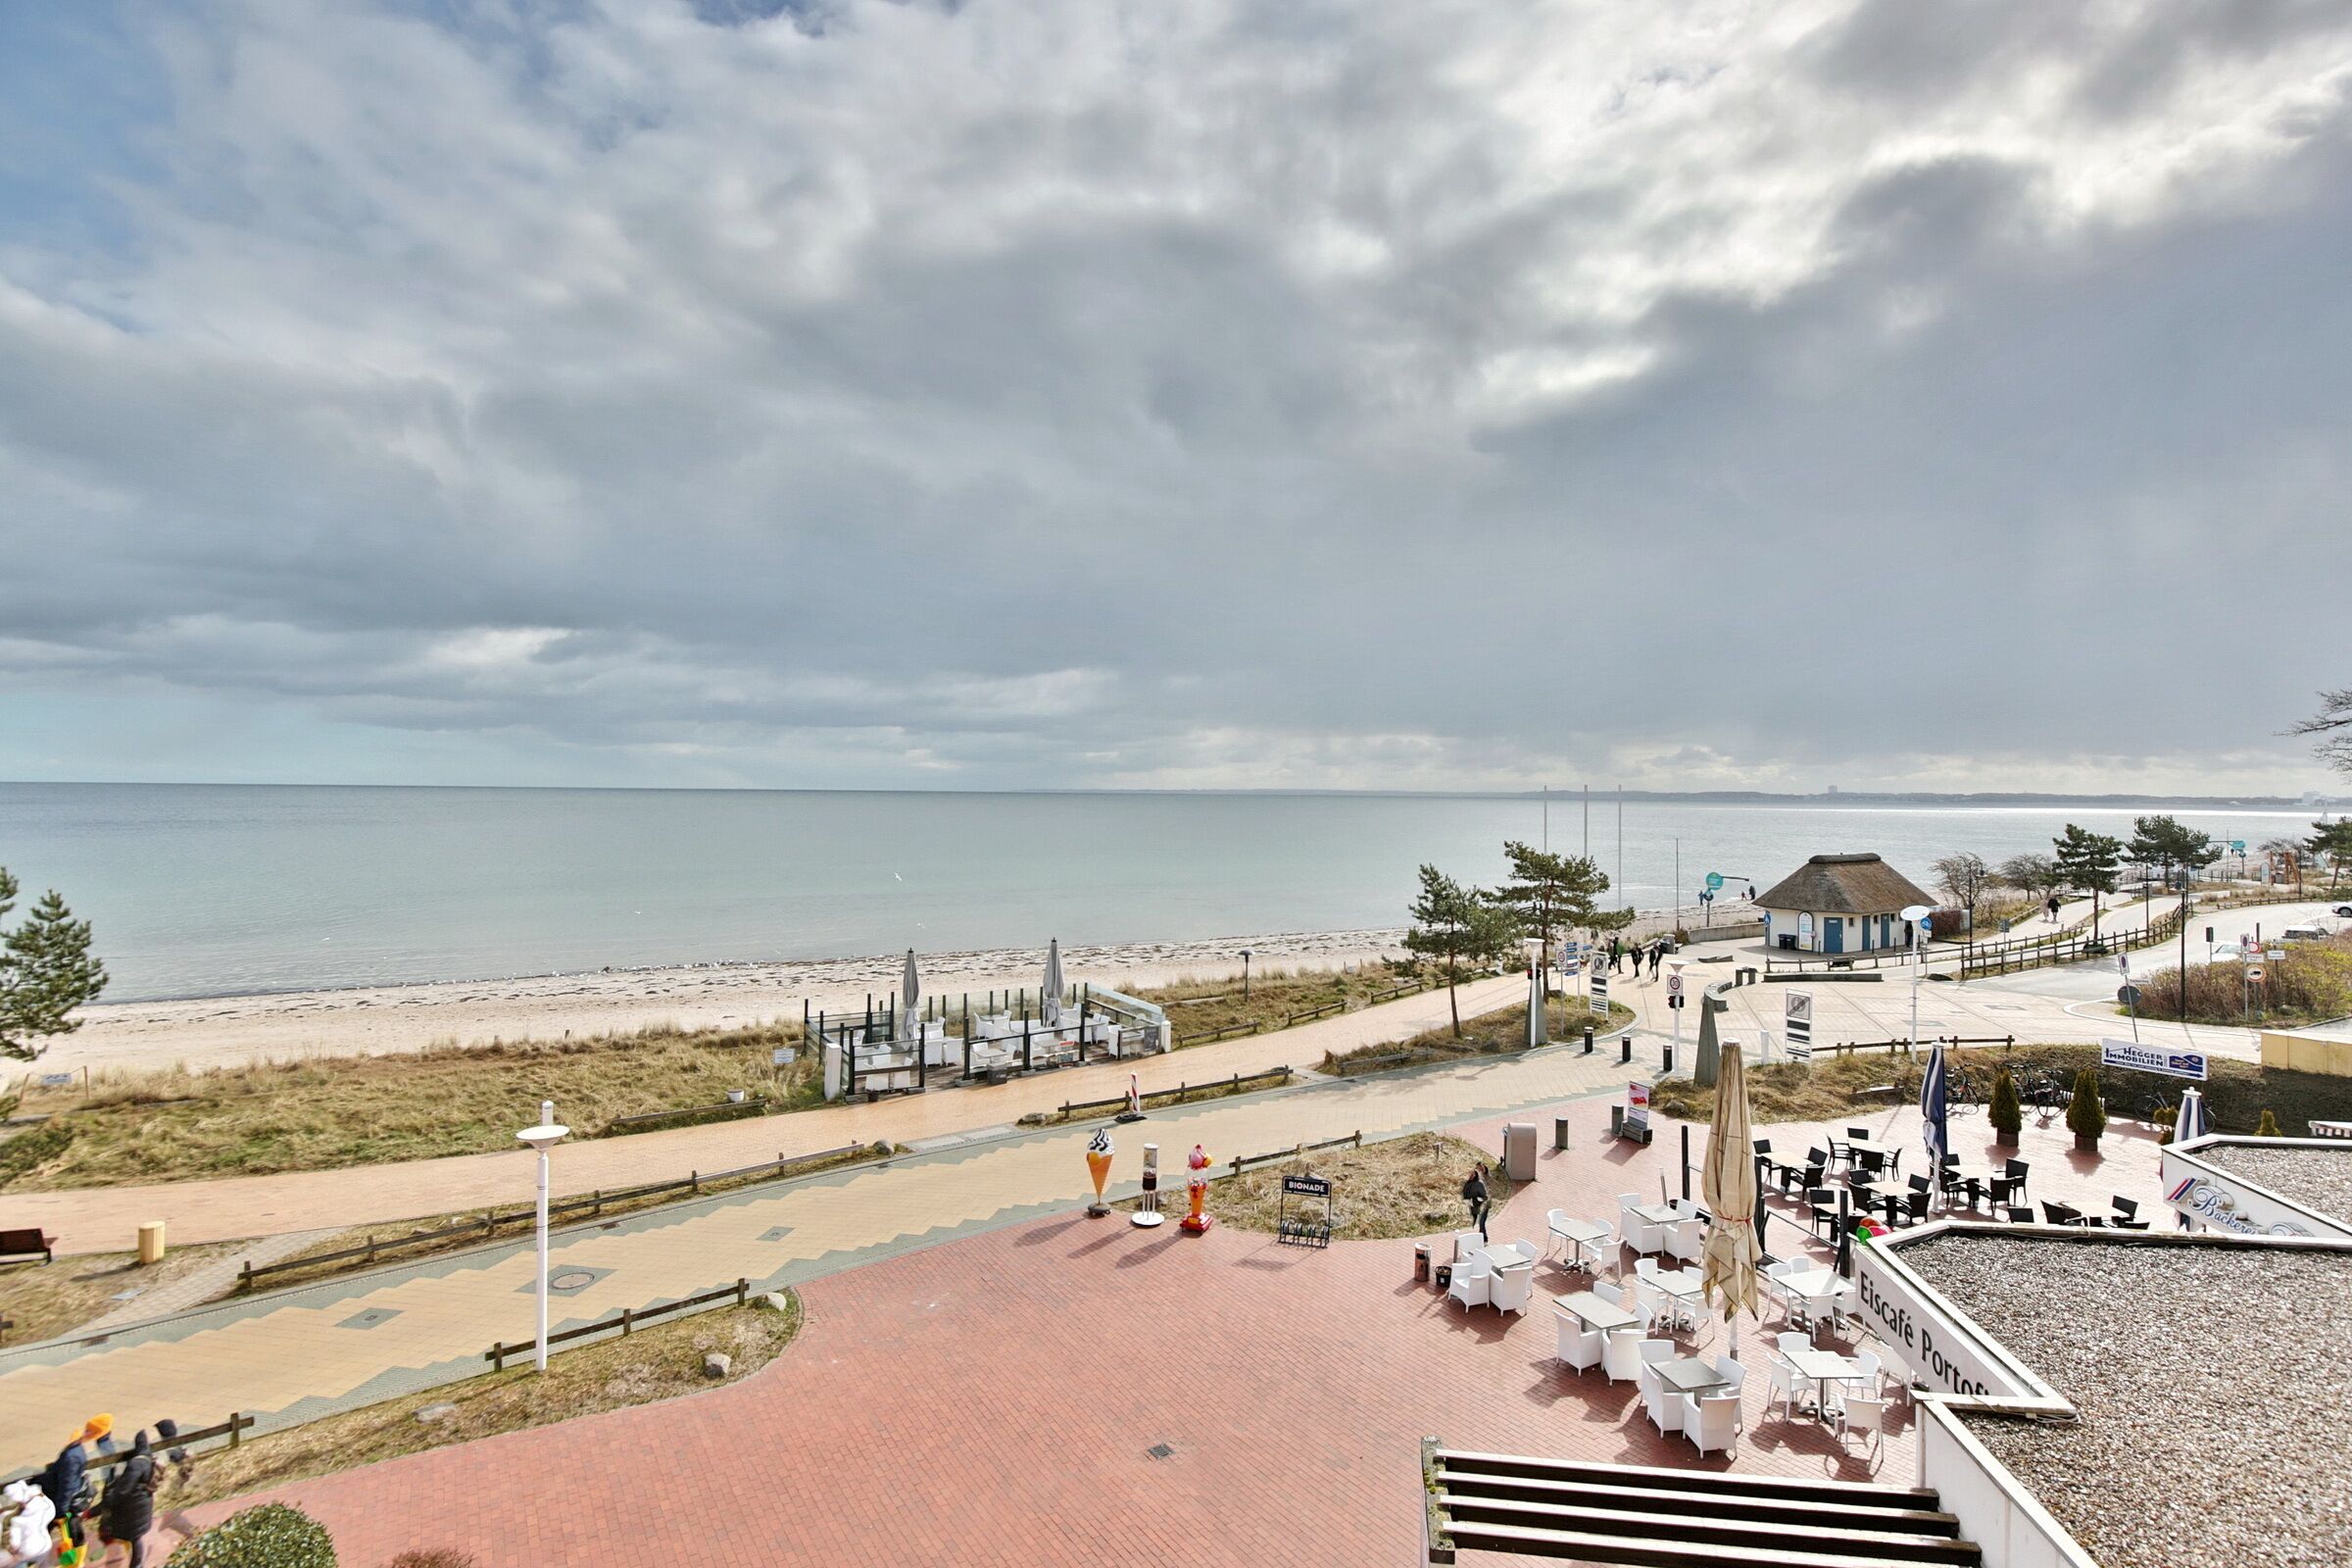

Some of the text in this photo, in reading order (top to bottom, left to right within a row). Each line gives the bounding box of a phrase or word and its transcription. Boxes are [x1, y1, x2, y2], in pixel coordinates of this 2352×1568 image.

[2106, 1048, 2163, 1066] IMMOBILIEN
[2124, 1047, 2162, 1060] HEGGER
[1289, 1181, 1325, 1193] BIONADE
[1861, 1271, 1989, 1396] Eiscafé Portof
